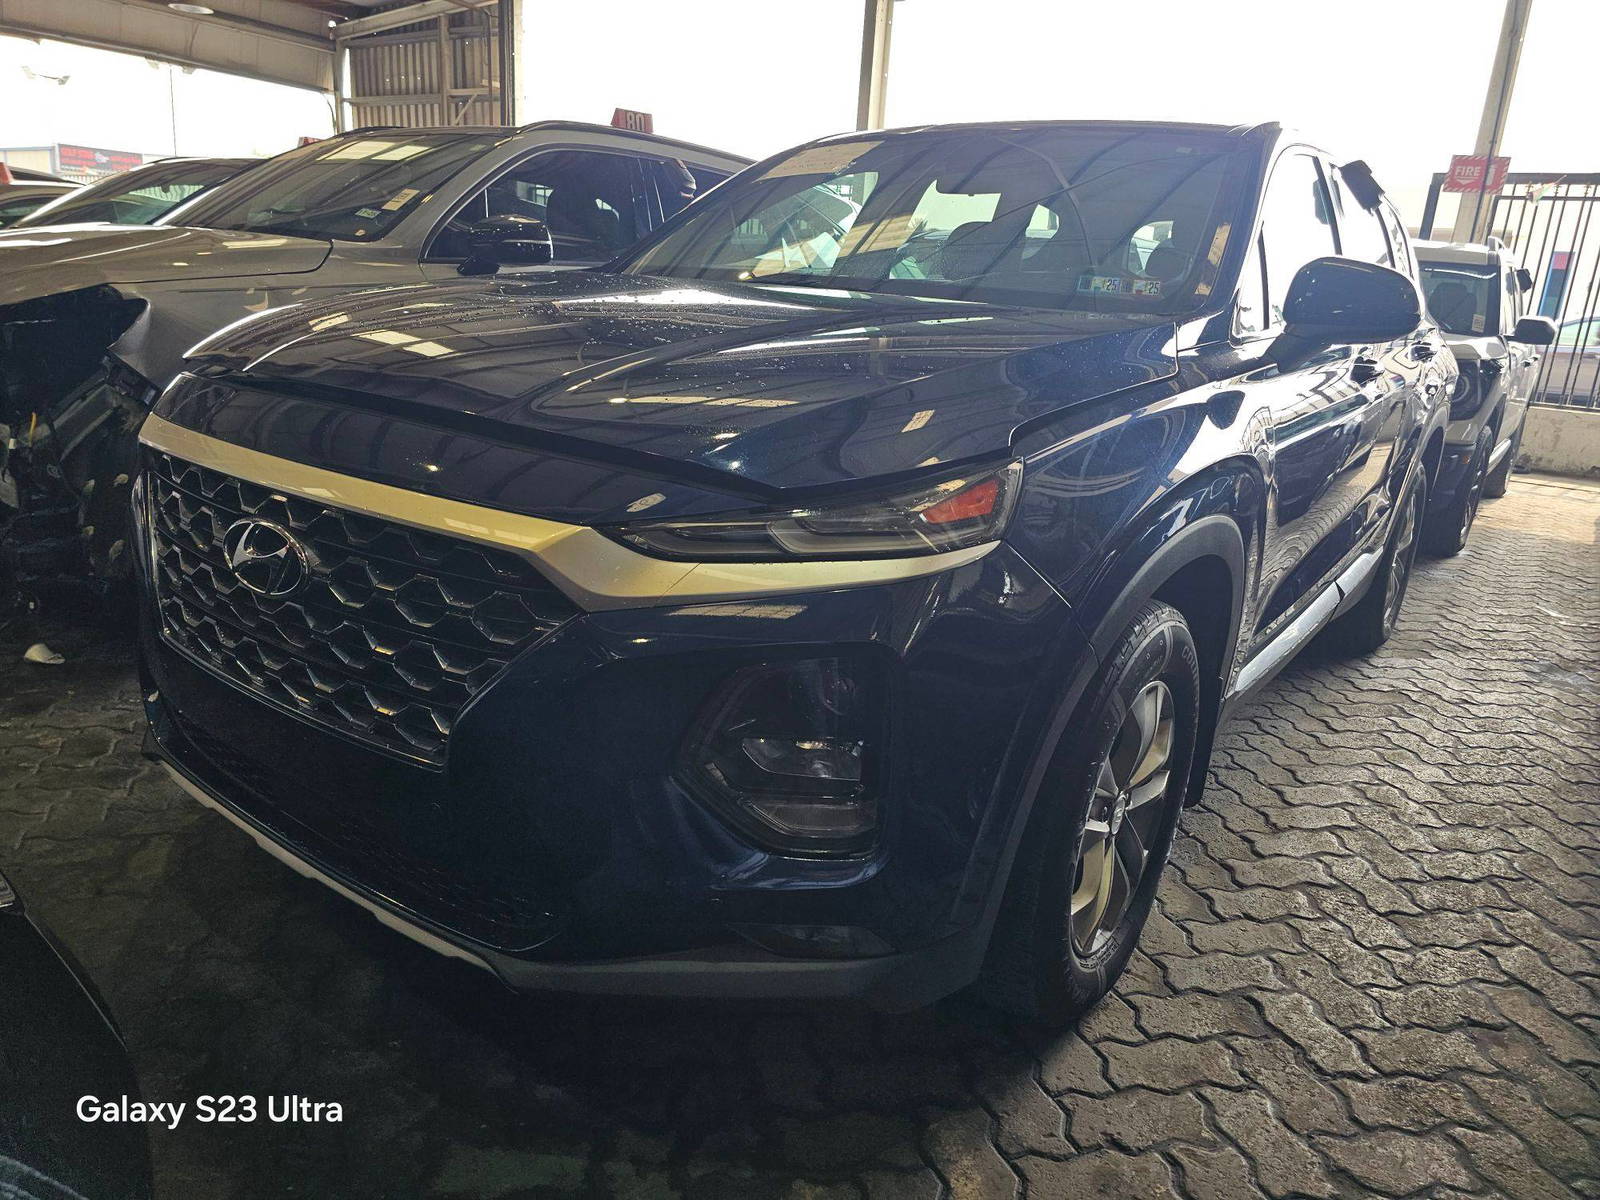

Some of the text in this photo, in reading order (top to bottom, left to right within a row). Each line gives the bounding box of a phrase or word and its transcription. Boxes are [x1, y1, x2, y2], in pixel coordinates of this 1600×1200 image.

[1455, 165, 1481, 177] FIRE
[1106, 279, 1118, 292] 25
[1148, 281, 1160, 295] 25
